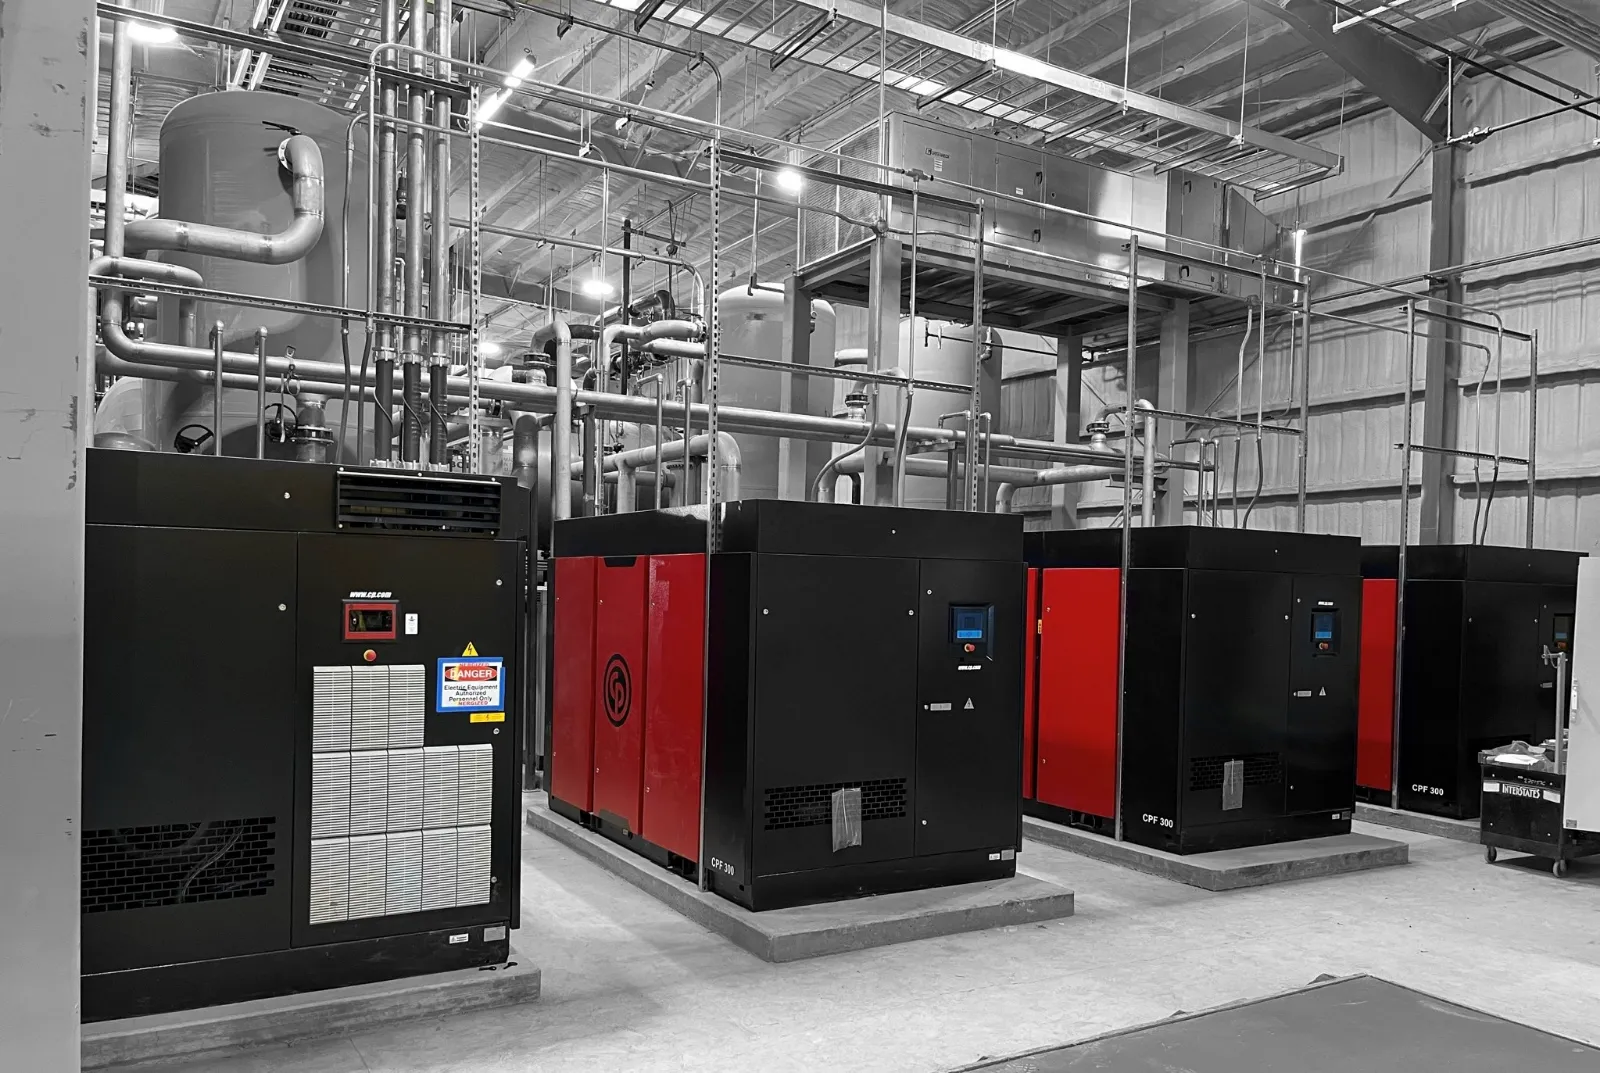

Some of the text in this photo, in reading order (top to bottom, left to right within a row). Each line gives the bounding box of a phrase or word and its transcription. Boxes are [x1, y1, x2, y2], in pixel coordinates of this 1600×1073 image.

[449, 669, 493, 678] DANGER
[1412, 784, 1444, 796] CPF 300
[1142, 813, 1173, 828] CPF 300
[711, 857, 735, 876] CPF 300
